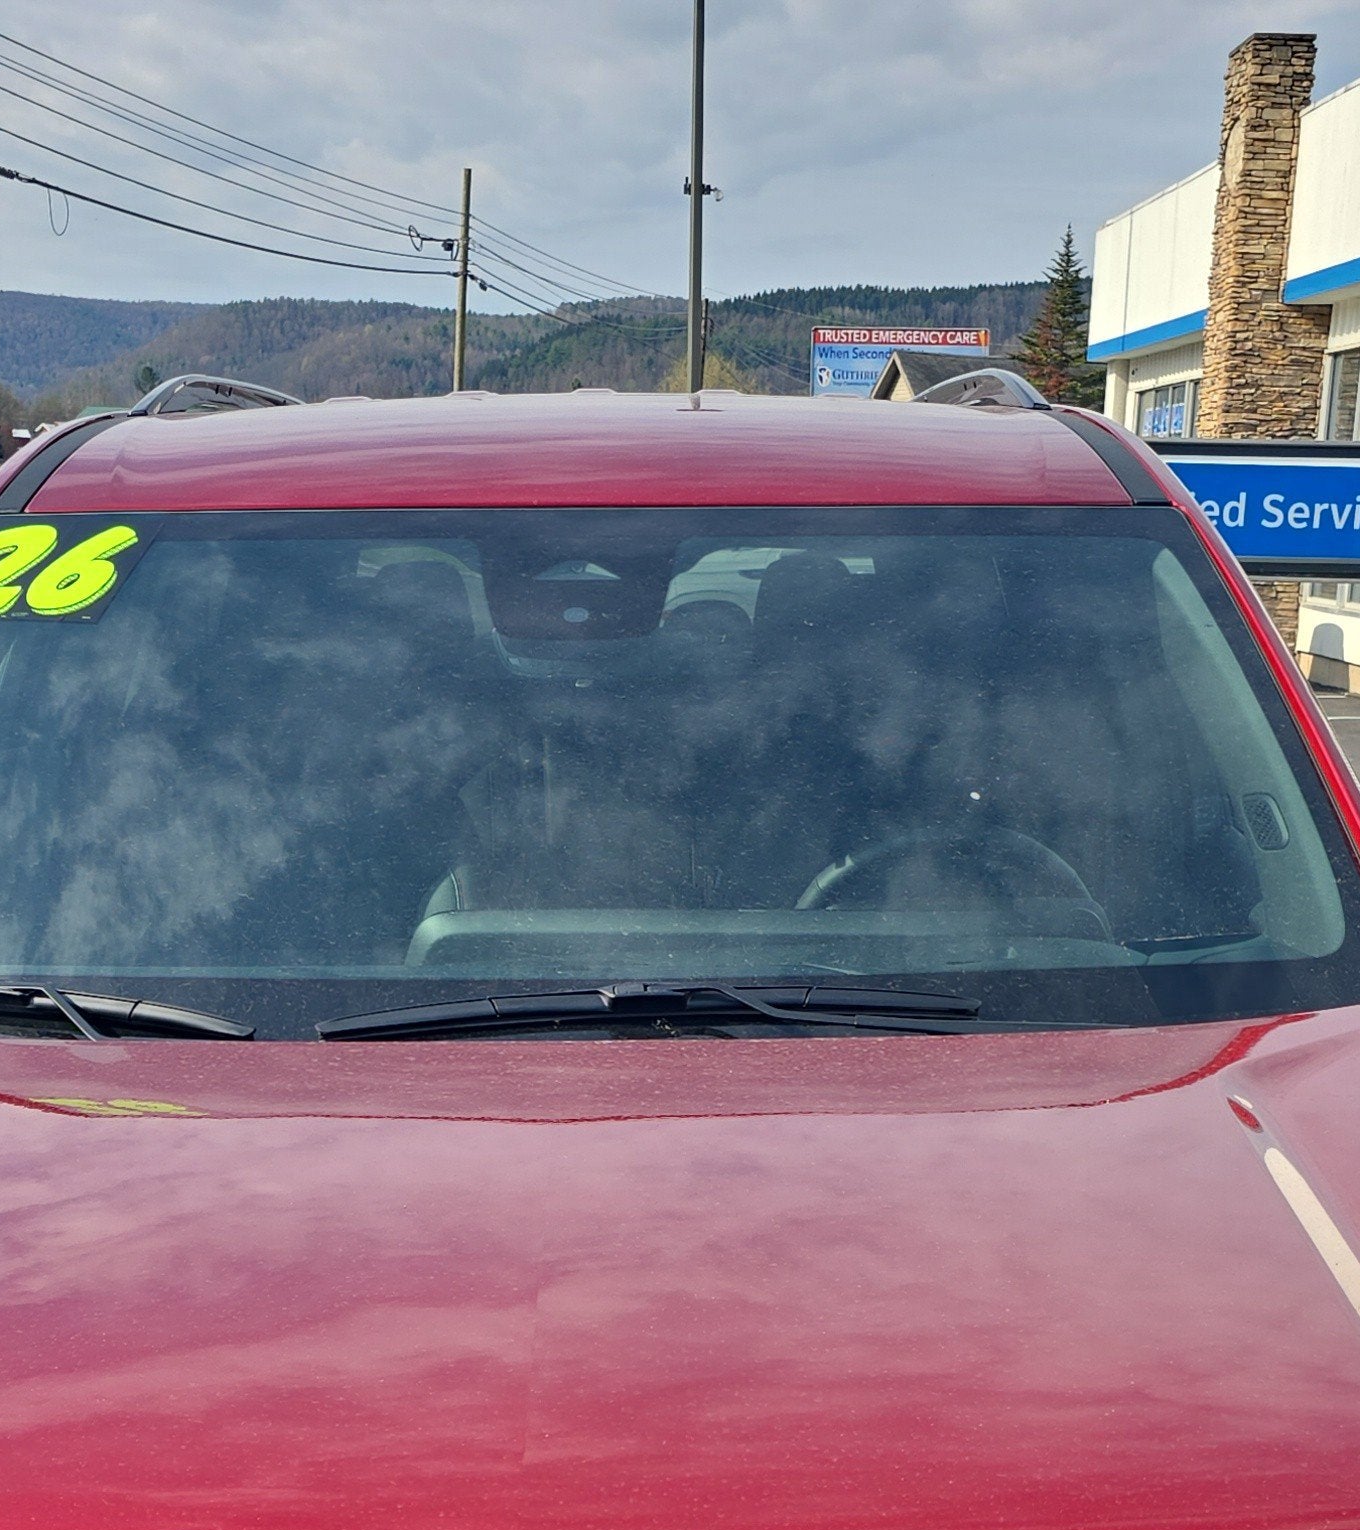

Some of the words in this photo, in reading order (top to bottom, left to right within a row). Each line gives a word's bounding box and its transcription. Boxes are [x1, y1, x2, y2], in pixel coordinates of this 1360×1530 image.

[818, 330, 870, 343] TRUSTED
[871, 331, 944, 344] EMERGENCY
[946, 331, 978, 345] CARE
[817, 347, 849, 360] When
[852, 347, 893, 360] Second
[1193, 491, 1247, 528] ed
